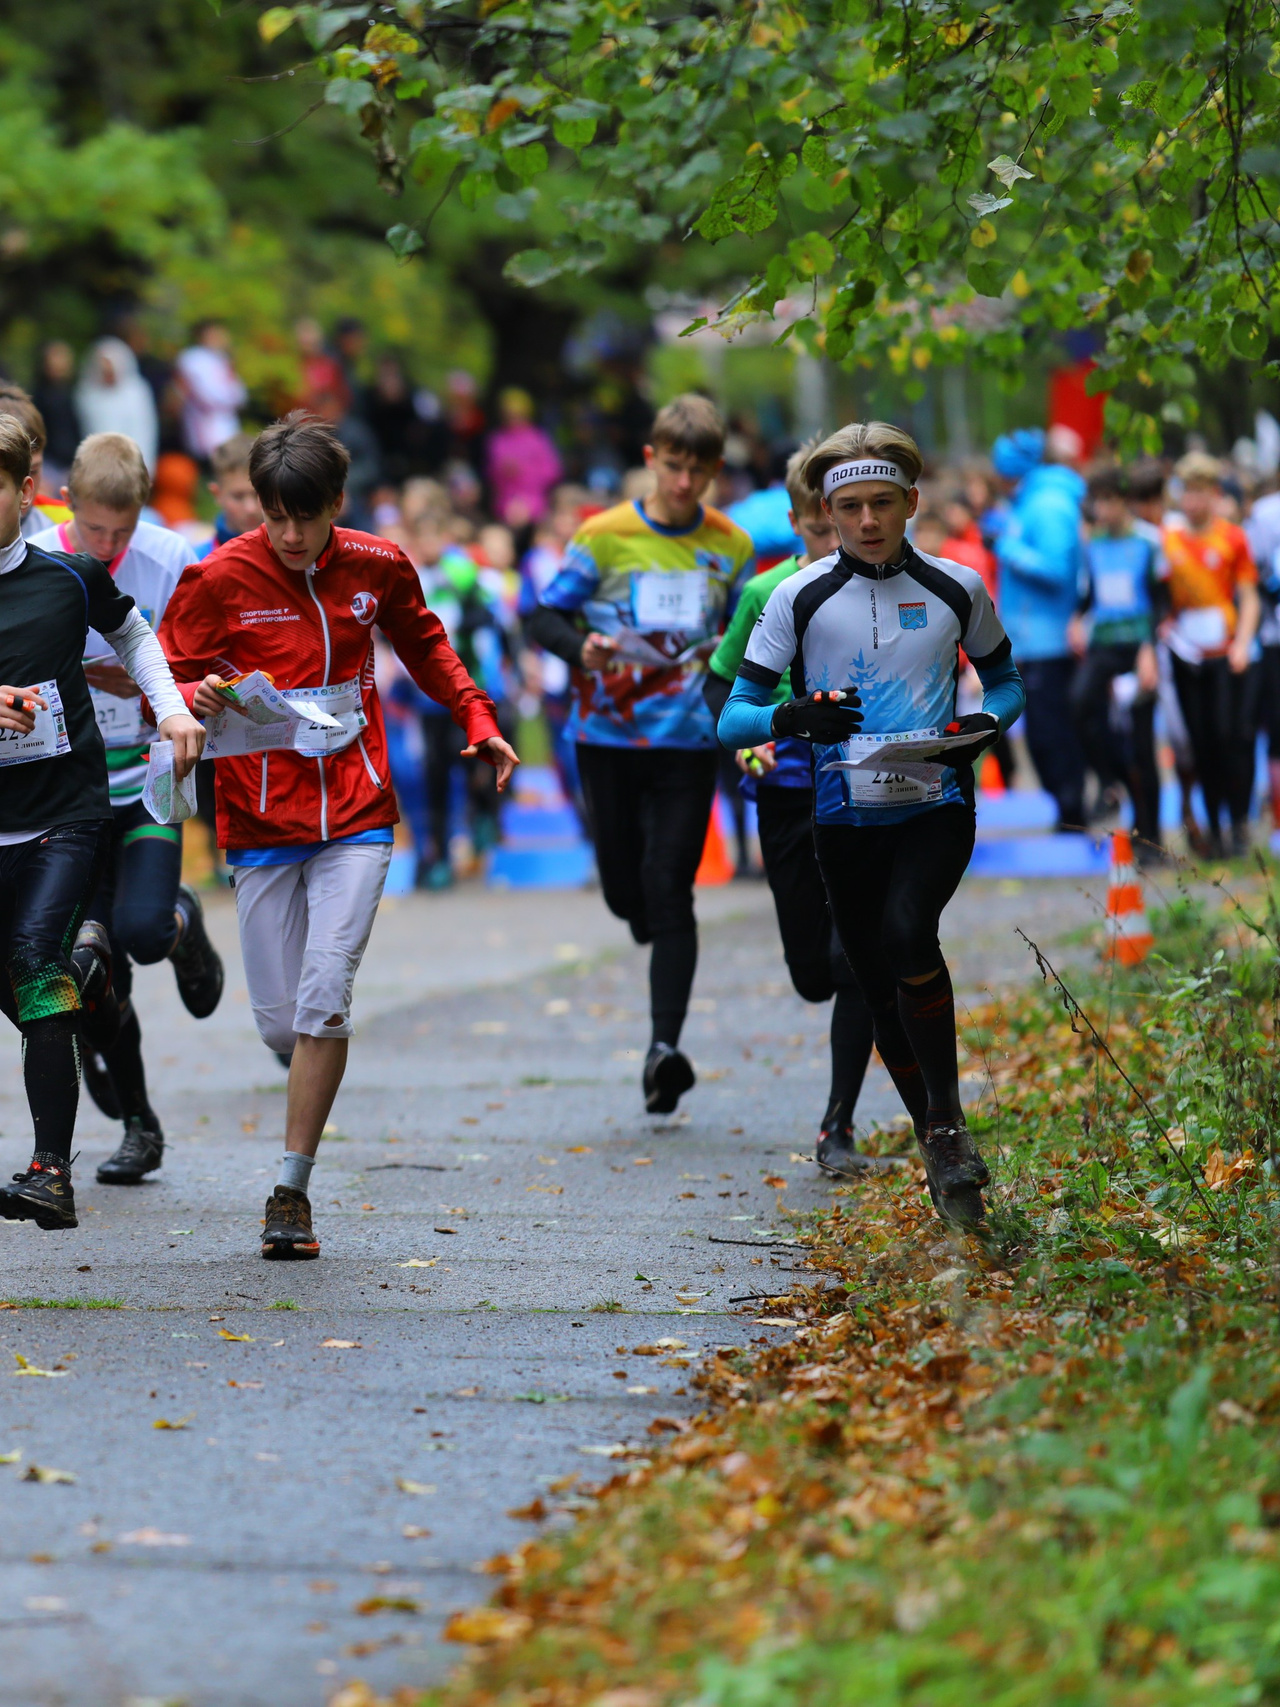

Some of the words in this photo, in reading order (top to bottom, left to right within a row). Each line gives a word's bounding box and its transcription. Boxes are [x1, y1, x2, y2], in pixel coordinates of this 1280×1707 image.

[832, 465, 896, 483] noname
[239, 608, 282, 618] СПОРТИВНОЕ
[240, 615, 300, 626] ОРИЕНТИРОВАНИЕ
[97, 708, 116, 724] 27
[21, 741, 45, 749] линия
